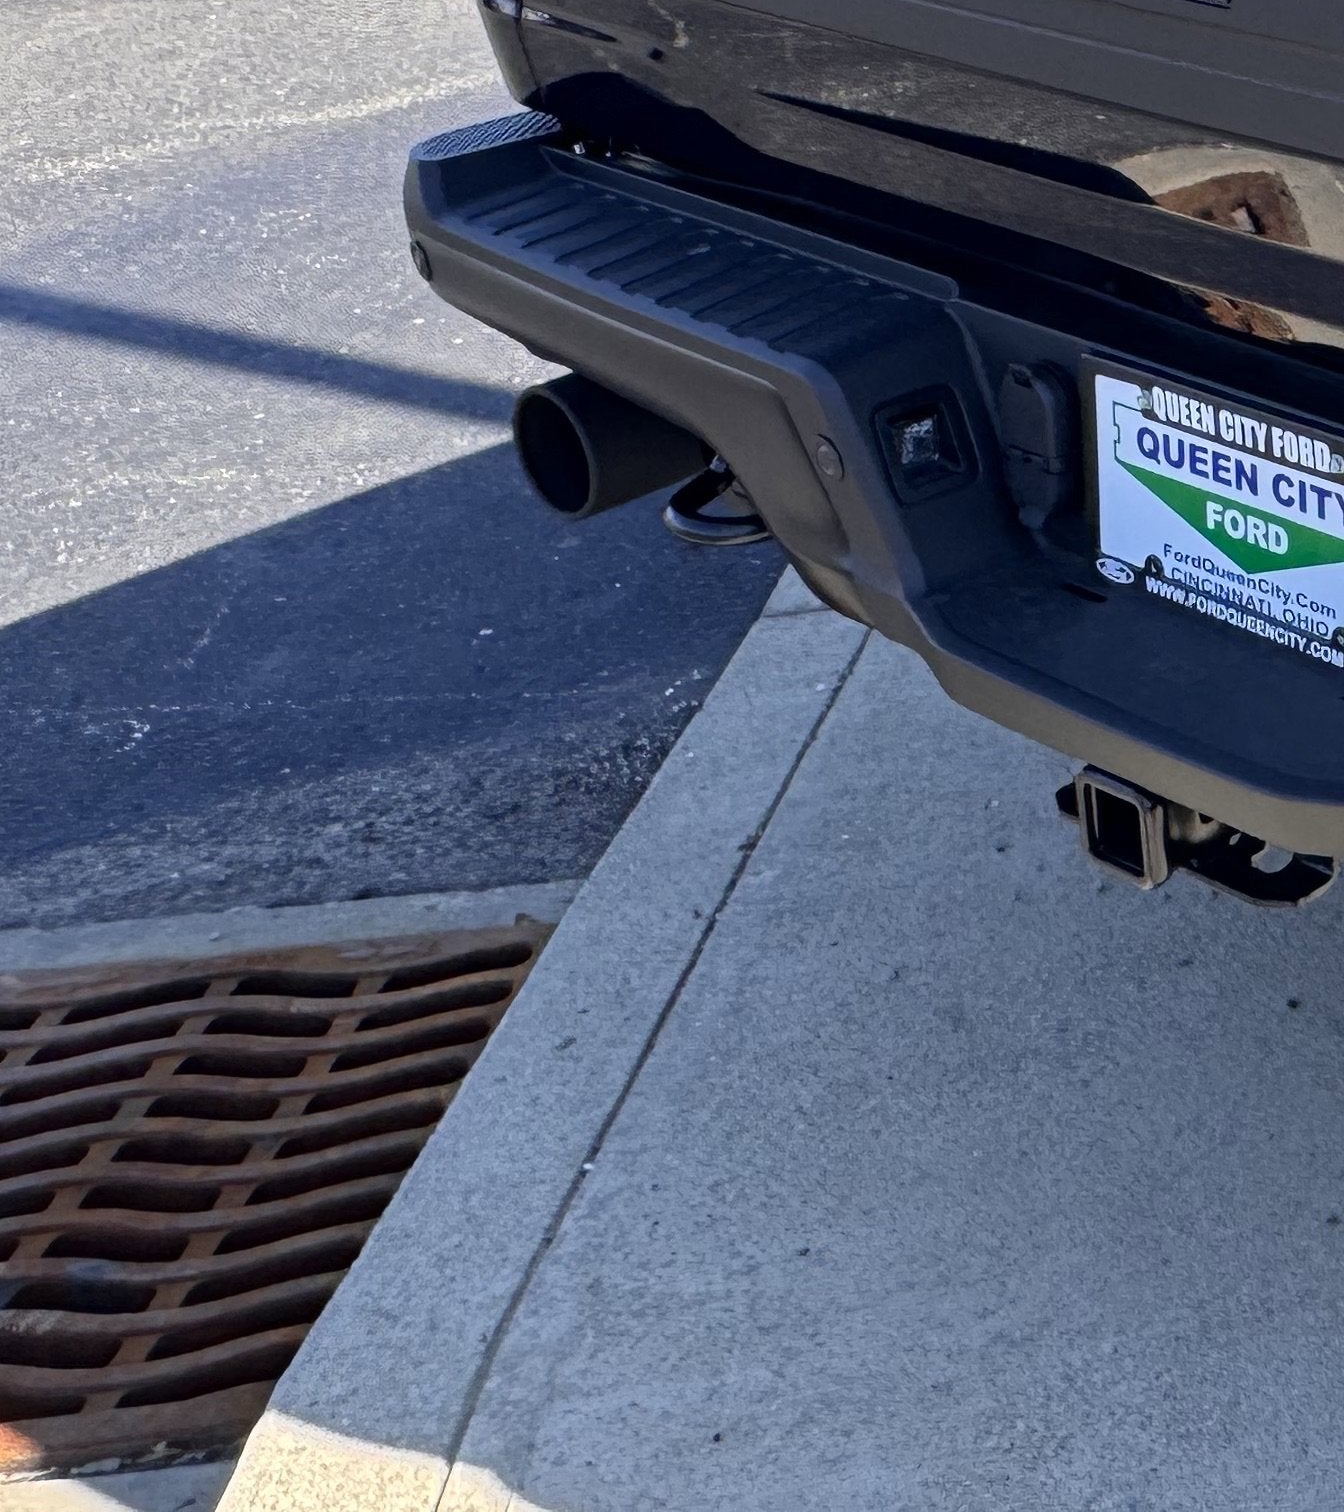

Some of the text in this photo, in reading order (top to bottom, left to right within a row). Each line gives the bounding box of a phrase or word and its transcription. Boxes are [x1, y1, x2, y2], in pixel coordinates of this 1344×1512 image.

[1151, 386, 1331, 470] QUEEN CITY FORD
[1136, 427, 1259, 496] QUEEN
[1206, 501, 1289, 555] FORD
[1283, 608, 1329, 636] OHIO
